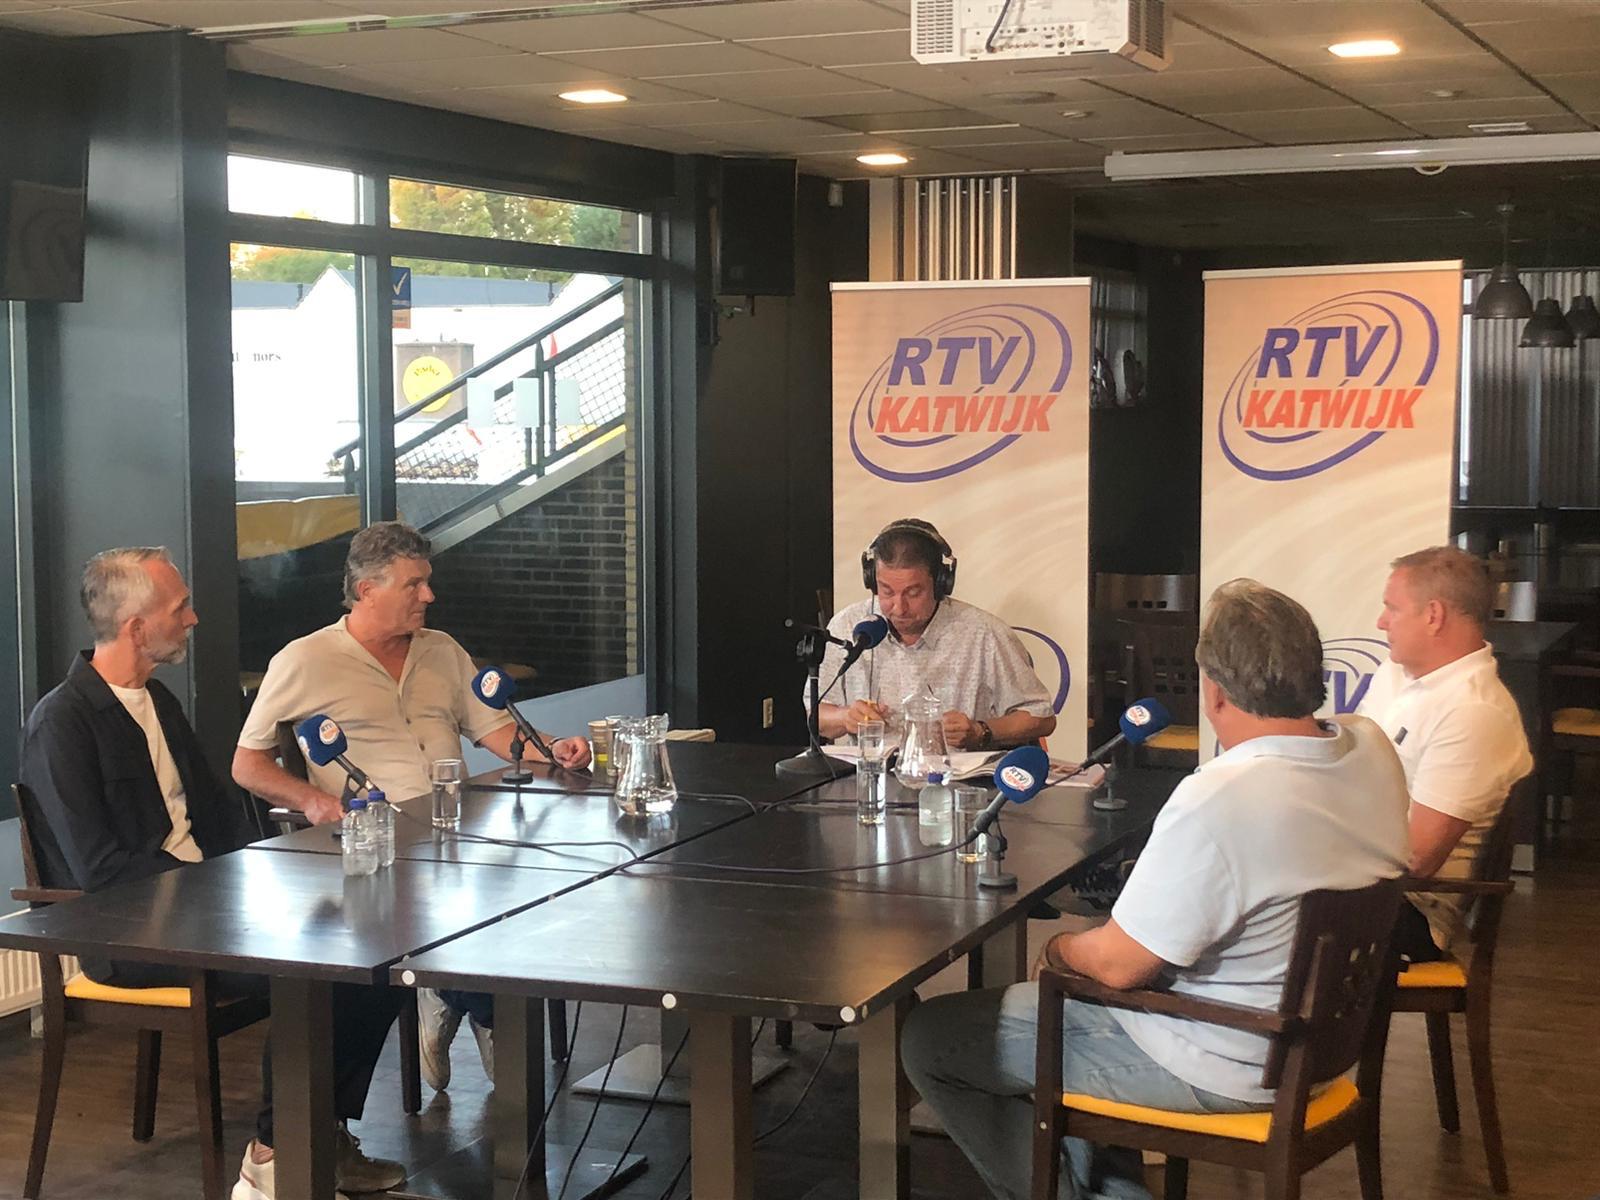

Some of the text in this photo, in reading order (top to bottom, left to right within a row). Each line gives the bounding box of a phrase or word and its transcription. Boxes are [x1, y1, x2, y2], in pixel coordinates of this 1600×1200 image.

[887, 336, 1022, 386] RTV
[1256, 325, 1389, 379] RTV
[874, 394, 1057, 433] KATWIJK
[1242, 388, 1424, 429] KATWIJK
[1010, 767, 1027, 781] RTV
